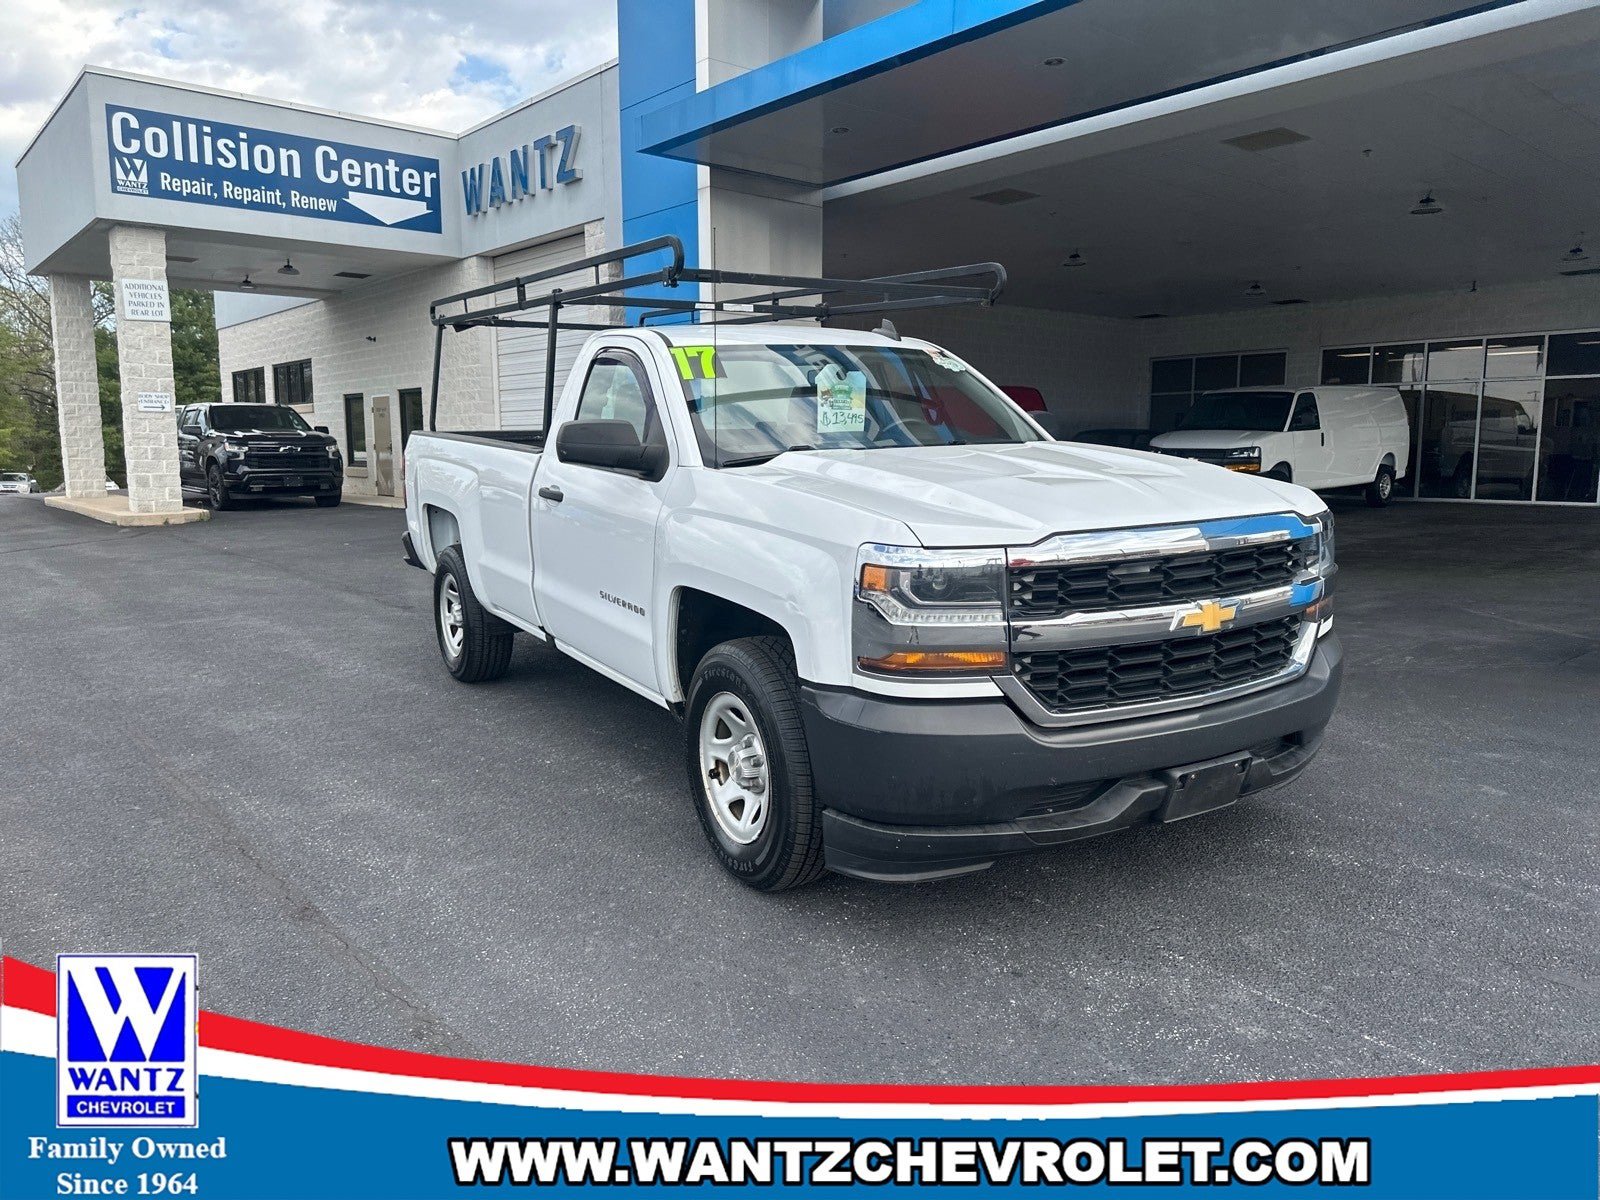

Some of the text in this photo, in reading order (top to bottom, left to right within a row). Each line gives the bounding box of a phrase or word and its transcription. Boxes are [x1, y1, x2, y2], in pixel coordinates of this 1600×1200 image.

[111, 111, 437, 198] Collision Center
[461, 124, 583, 217] WANTZ
[117, 179, 149, 190] WANTZ
[160, 172, 337, 213] Repair, Repaint, Renew
[124, 283, 165, 291] ADDITIONAL
[129, 291, 163, 300] VEHICLES
[128, 300, 155, 308] PARKED
[131, 308, 164, 317] REAR LOT
[668, 345, 717, 380] 17
[599, 590, 646, 617] SILVERADO
